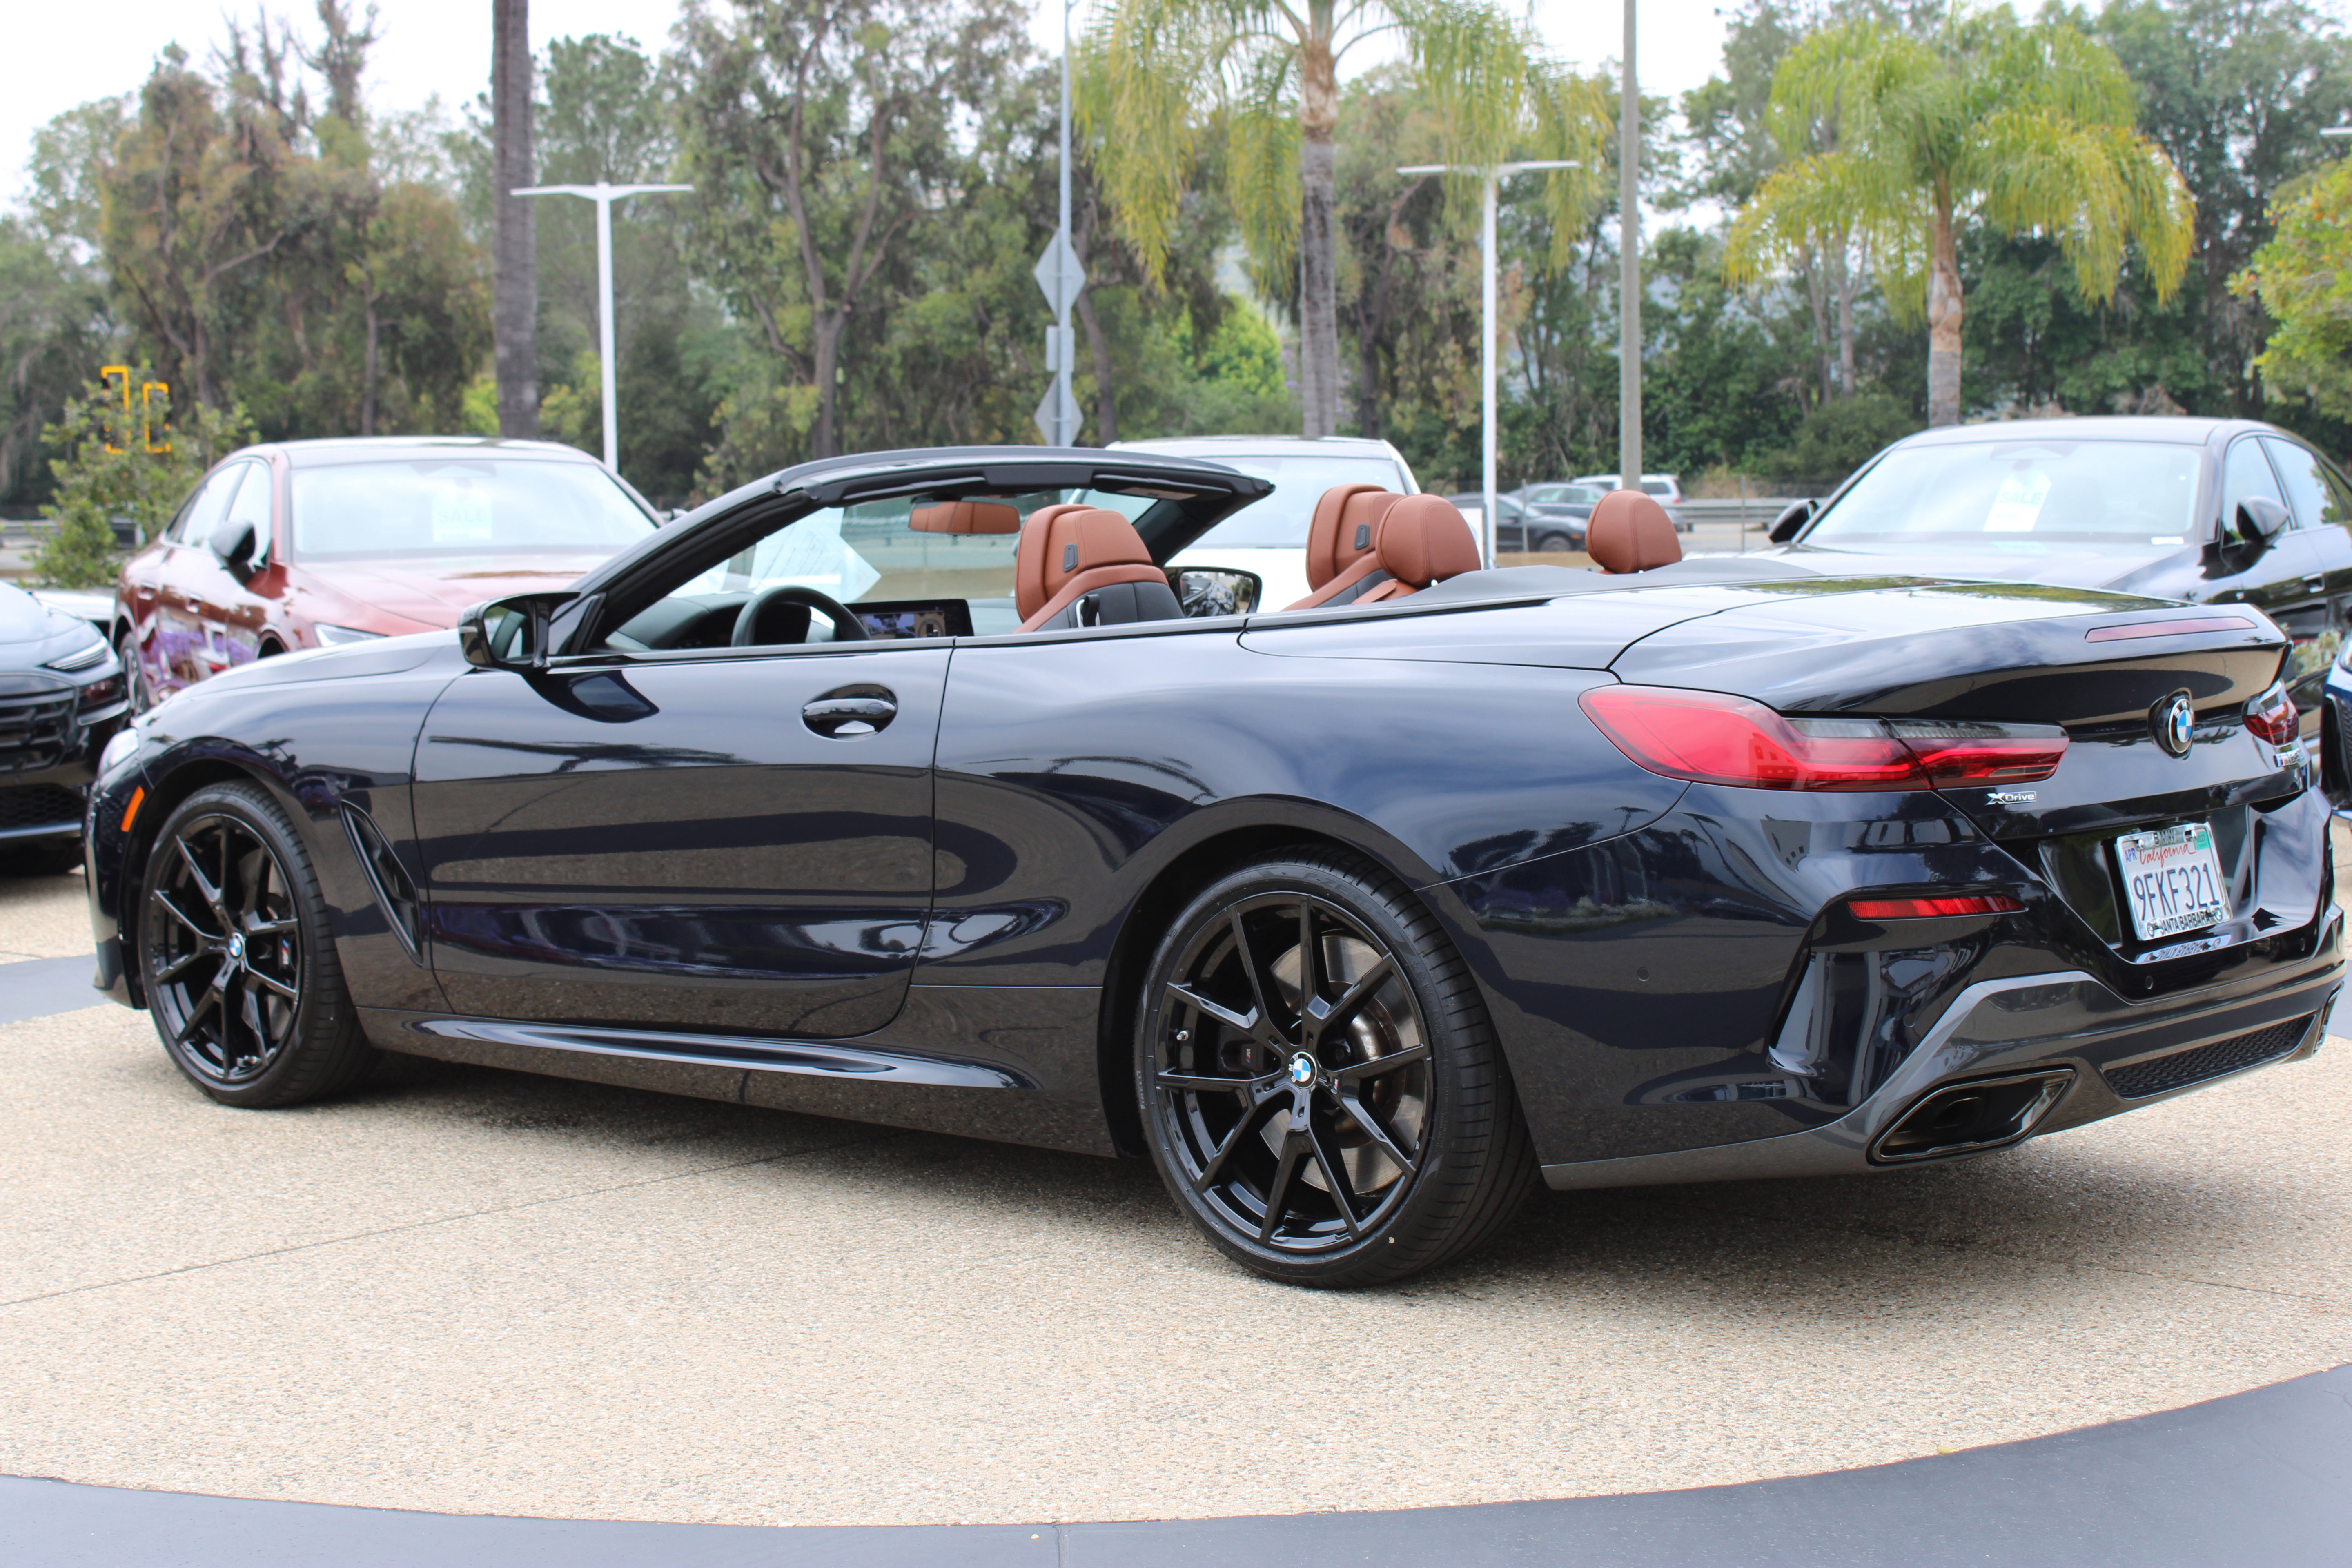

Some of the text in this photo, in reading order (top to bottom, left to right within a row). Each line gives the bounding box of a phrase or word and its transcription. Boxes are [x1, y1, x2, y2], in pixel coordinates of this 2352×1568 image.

[1998, 491, 2043, 505] SALE
[437, 508, 487, 524] SALE
[2153, 829, 2175, 844] BMW
[2125, 848, 2138, 863] APR
[2140, 844, 2196, 868] California
[2133, 862, 2219, 921] 9FKF321
